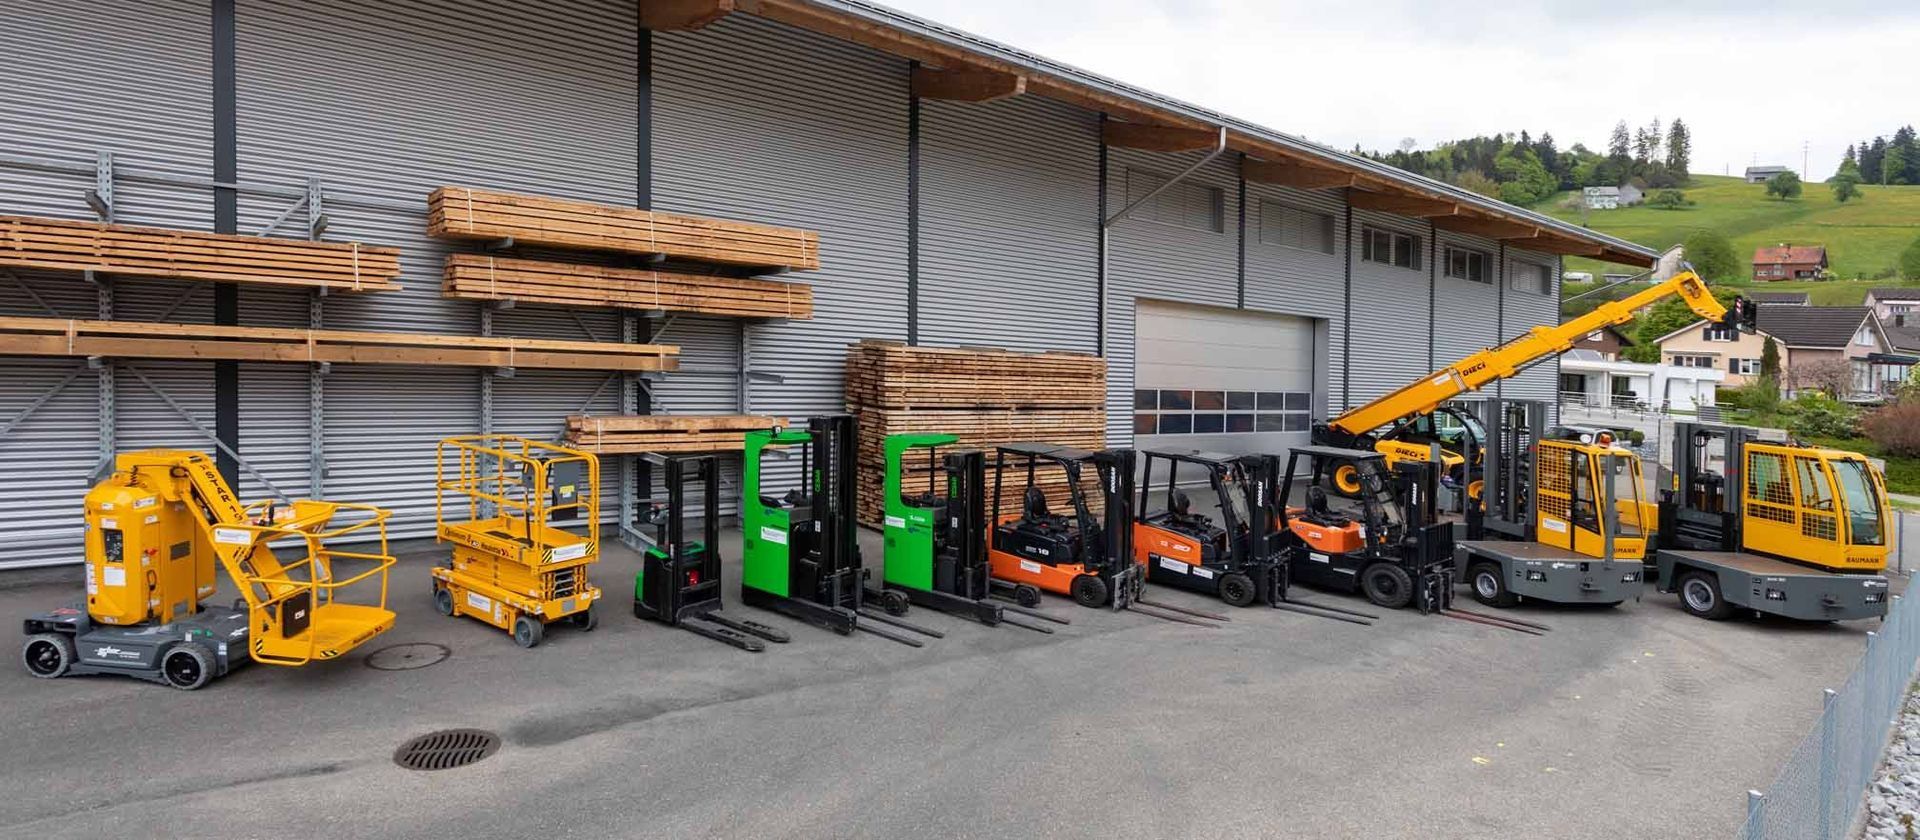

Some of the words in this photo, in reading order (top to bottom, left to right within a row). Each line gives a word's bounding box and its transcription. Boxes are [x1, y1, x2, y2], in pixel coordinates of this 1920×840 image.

[1462, 361, 1486, 376] DIECI
[1395, 447, 1418, 457] DIECI
[205, 471, 231, 502] STAR
